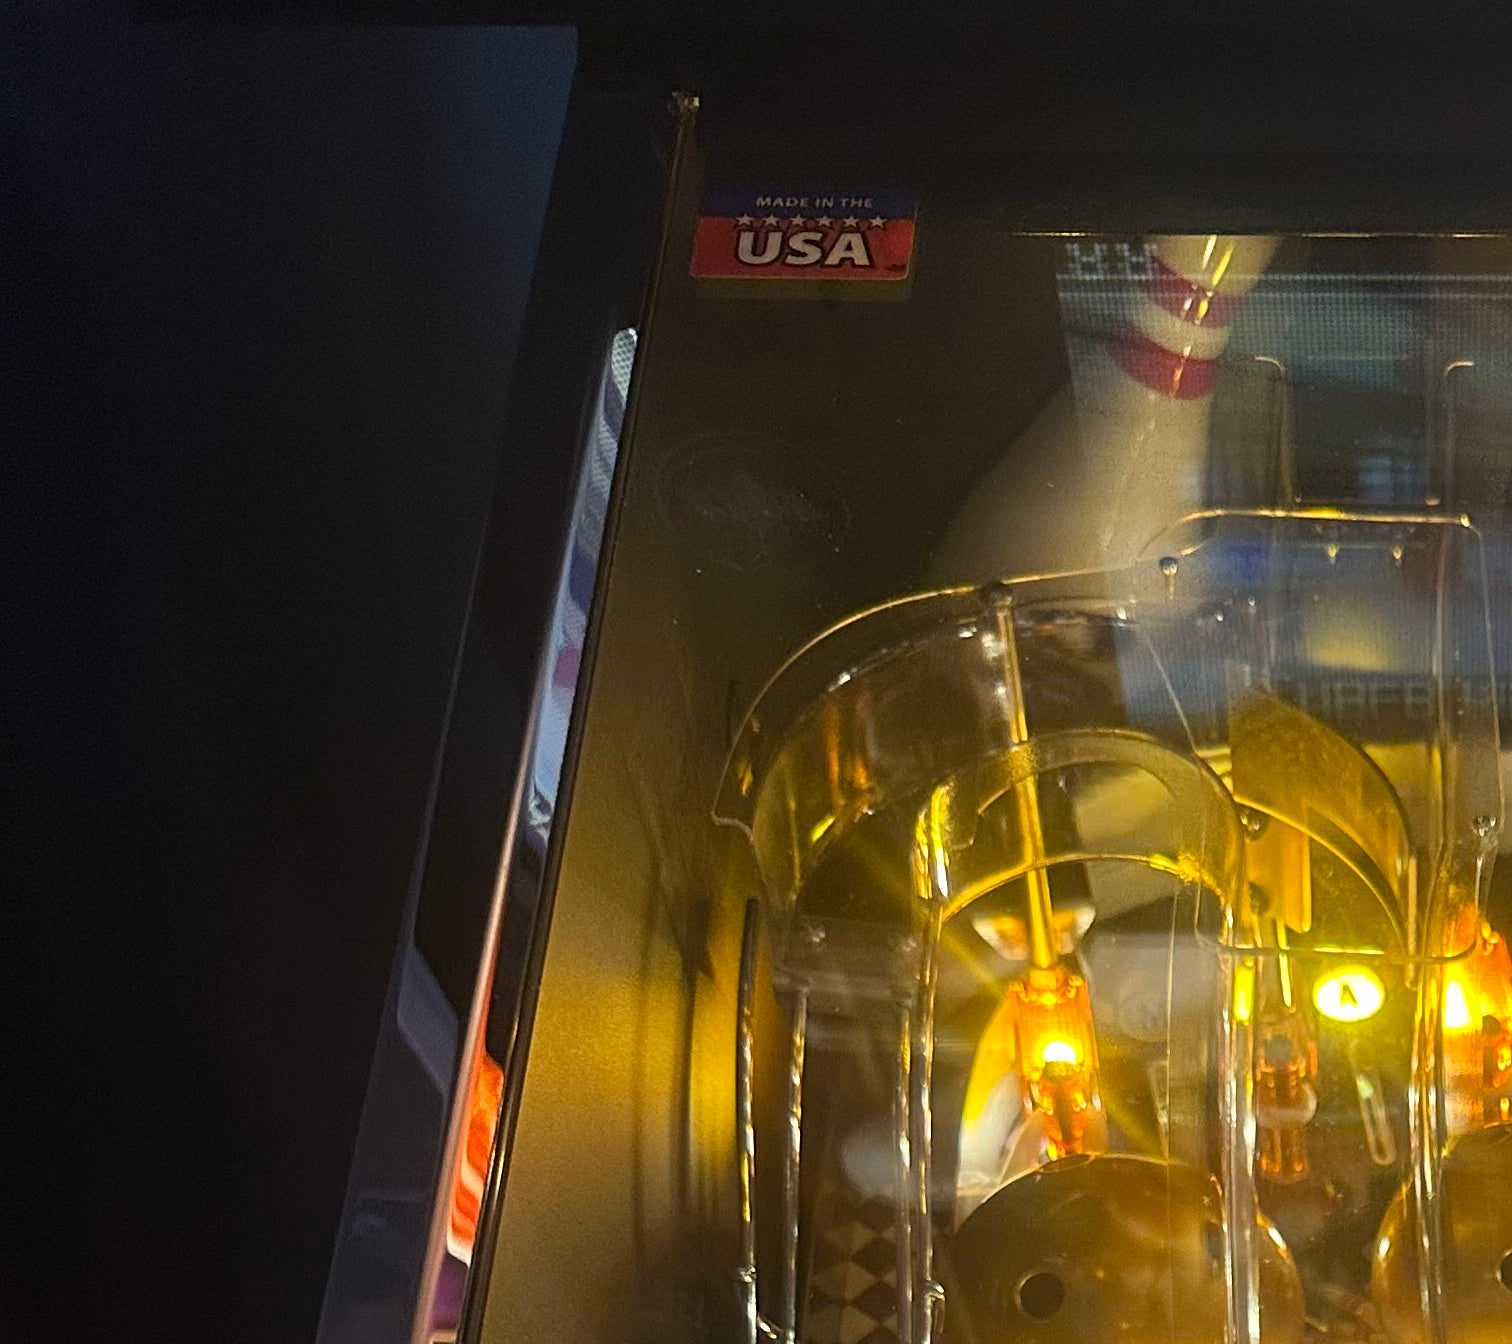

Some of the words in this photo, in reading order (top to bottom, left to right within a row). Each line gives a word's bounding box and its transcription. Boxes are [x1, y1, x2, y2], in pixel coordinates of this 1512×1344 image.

[755, 196, 809, 209] MADE
[815, 196, 834, 209] IN
[839, 197, 874, 209] THE
[736, 230, 871, 267] USA
